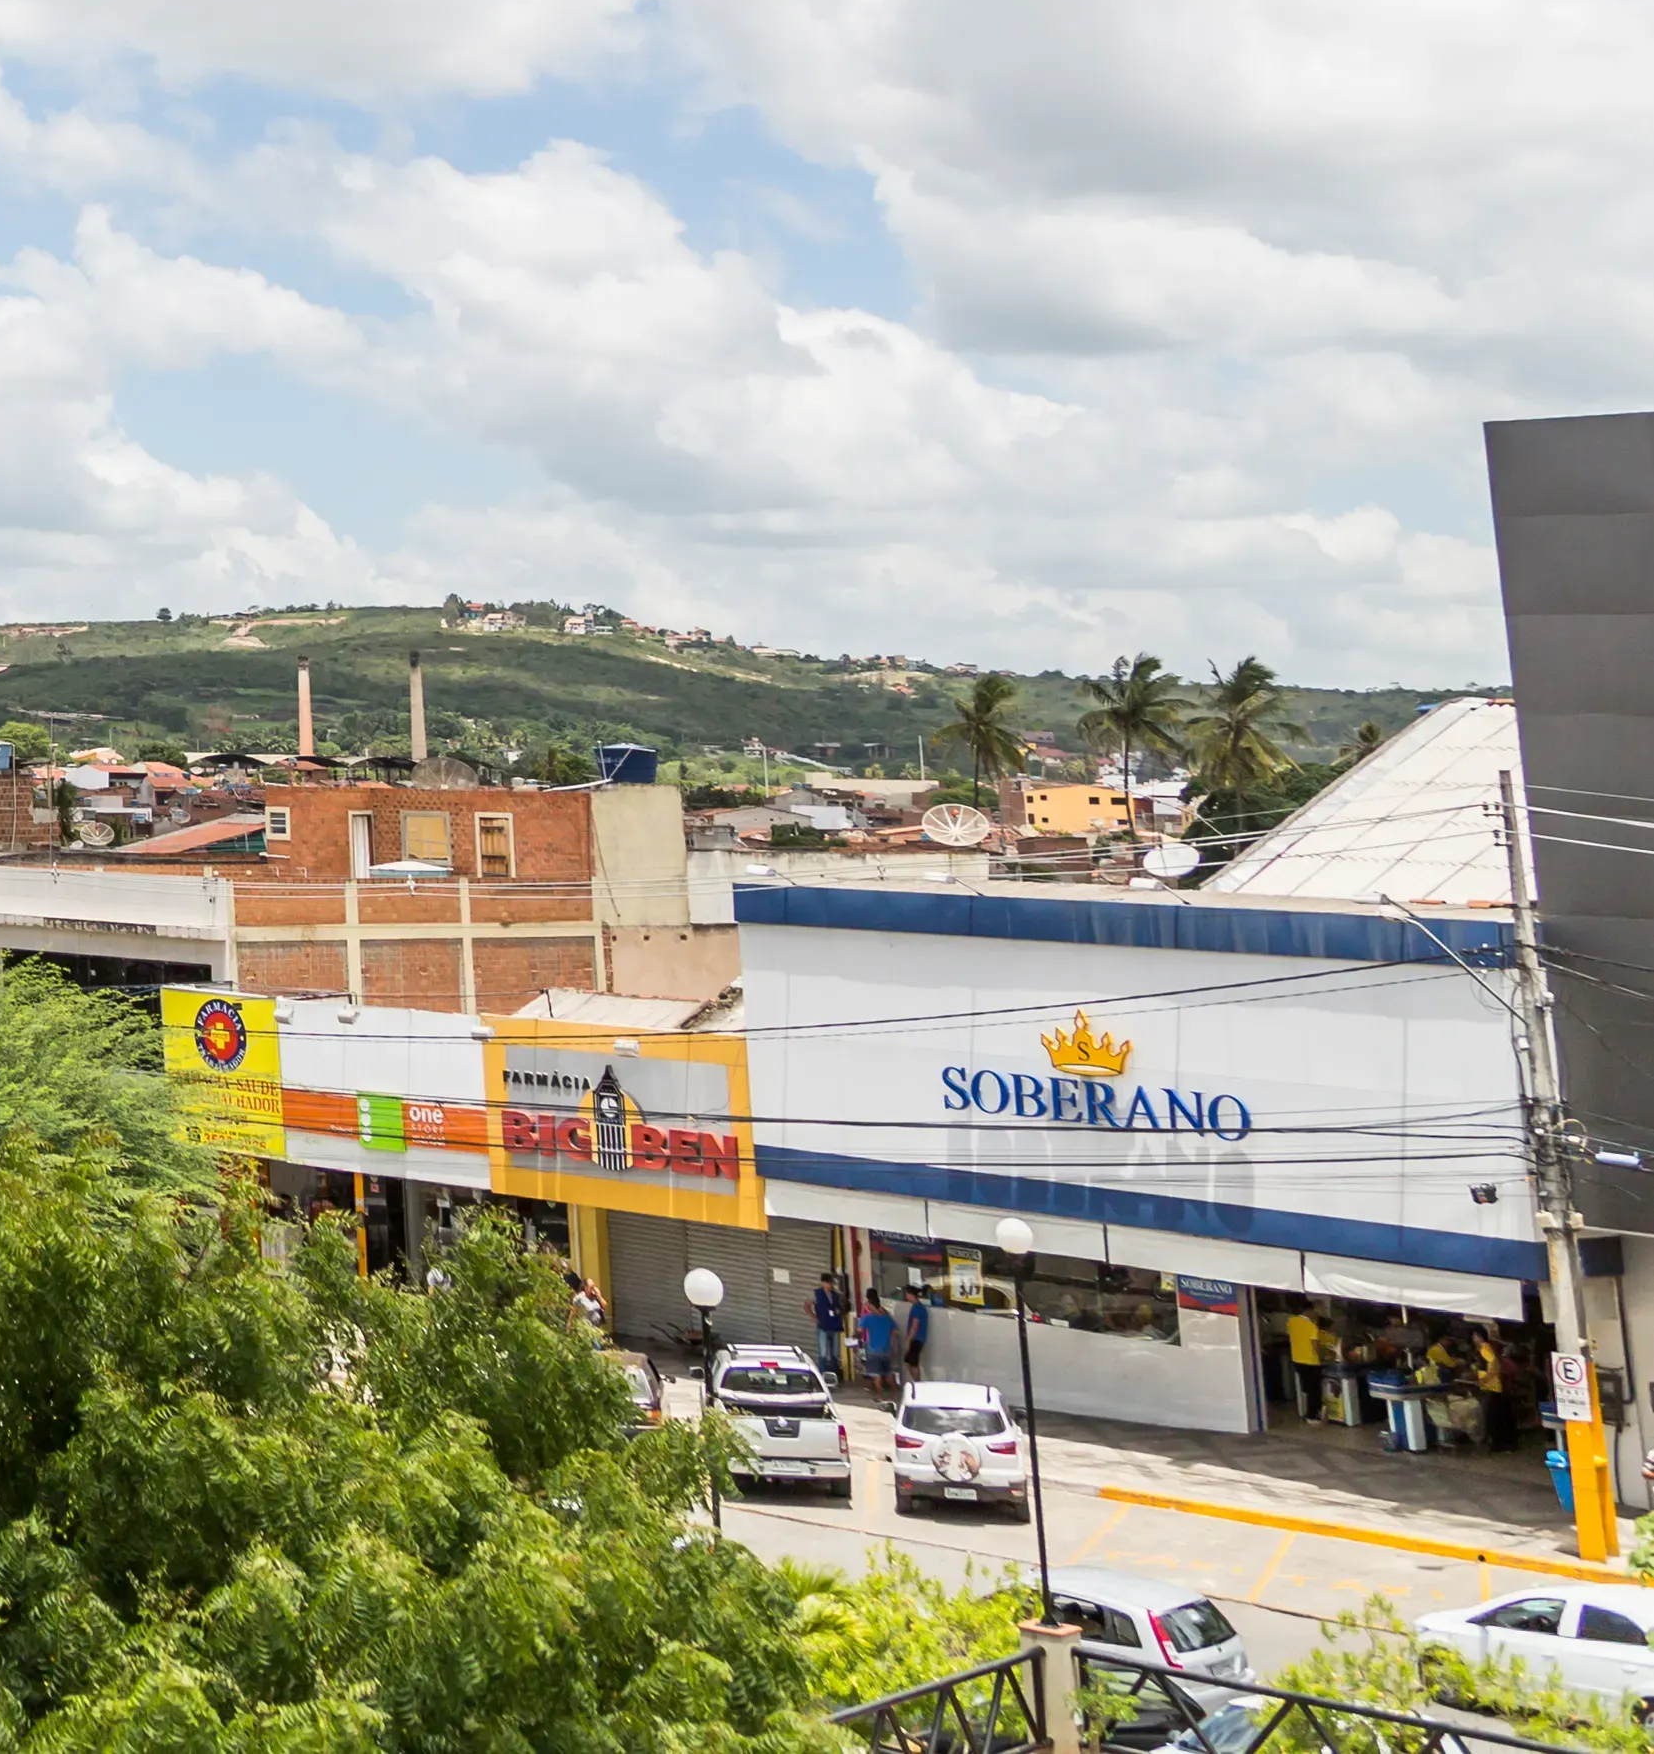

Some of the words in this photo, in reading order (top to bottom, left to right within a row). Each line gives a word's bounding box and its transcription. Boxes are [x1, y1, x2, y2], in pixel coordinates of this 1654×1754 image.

[1077, 1041, 1090, 1061] S
[502, 1069, 592, 1091] FARMÁCIA
[941, 1065, 1253, 1142] SOBERANO
[409, 1106, 444, 1123] one
[501, 1109, 592, 1162] BIG
[630, 1123, 740, 1181] BEN
[1179, 1277, 1233, 1295] SOBERANO
[1562, 1361, 1576, 1381] E
